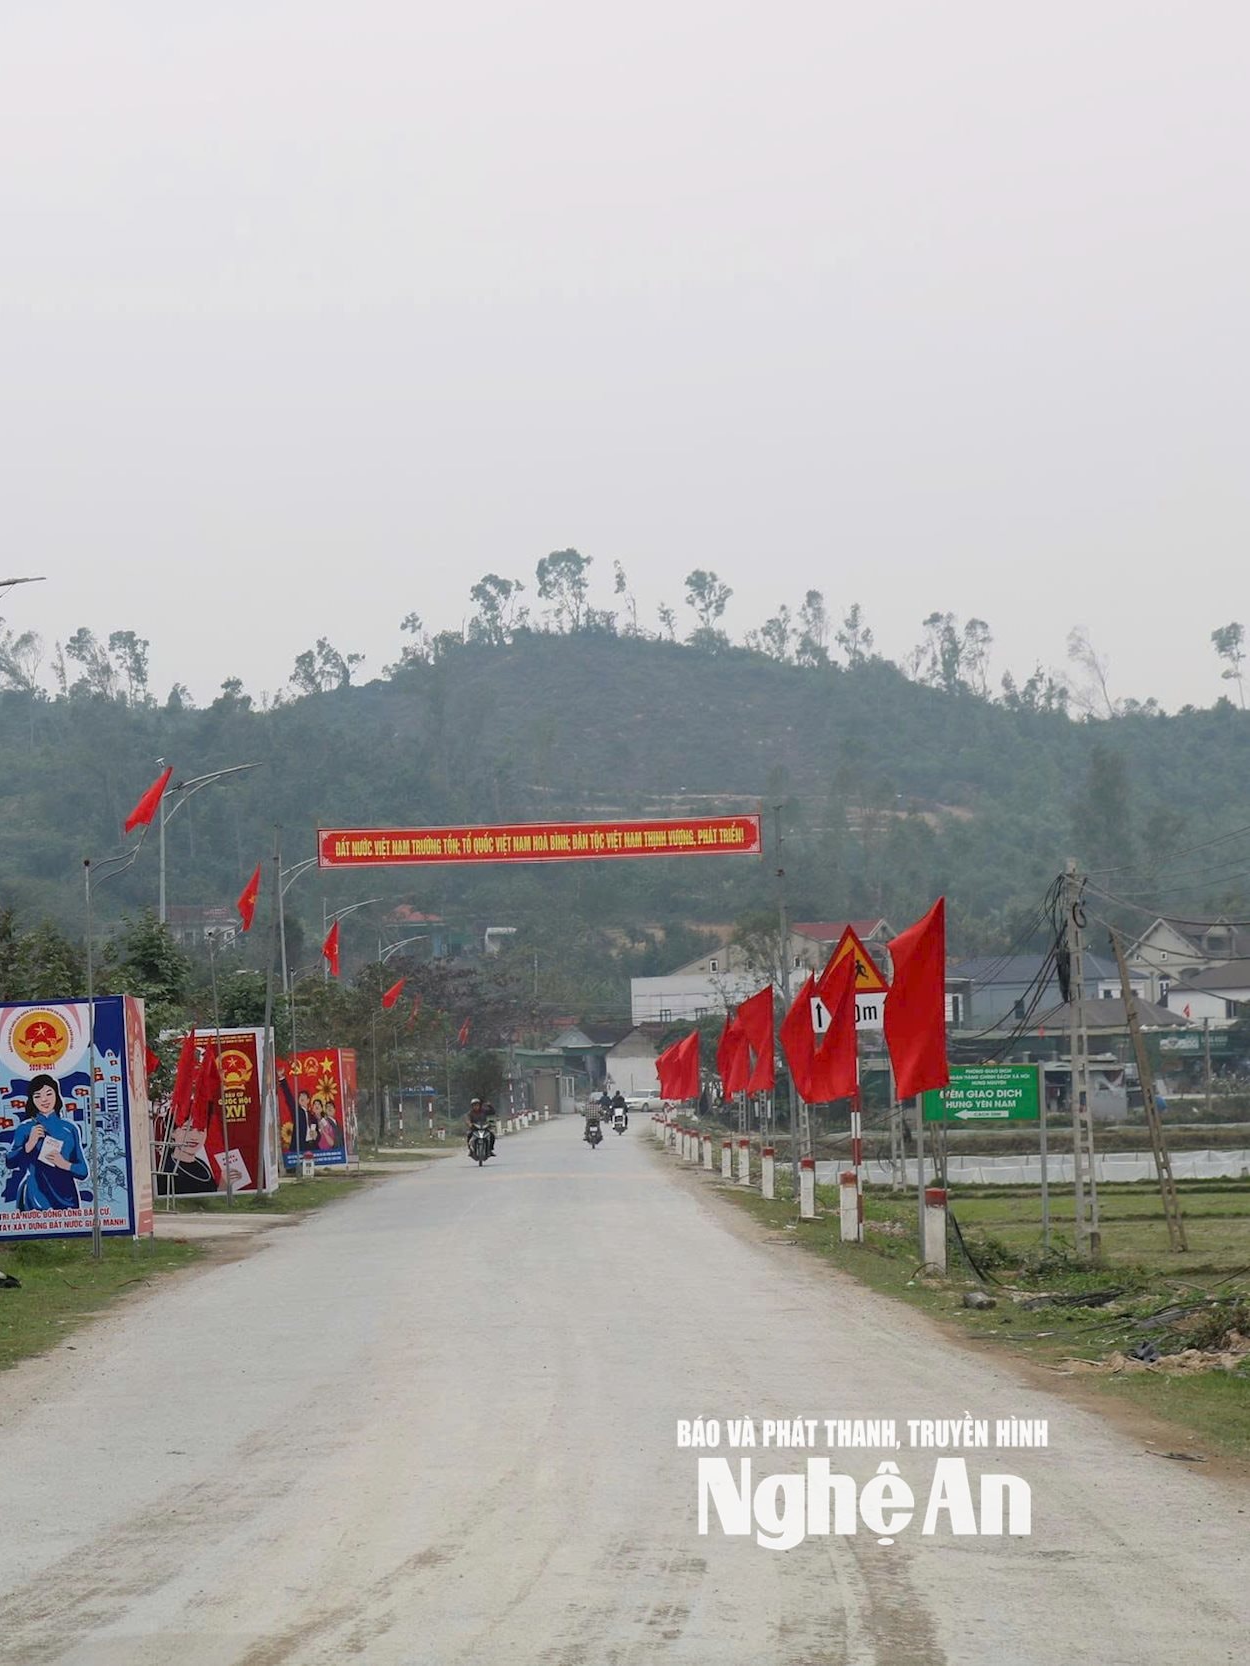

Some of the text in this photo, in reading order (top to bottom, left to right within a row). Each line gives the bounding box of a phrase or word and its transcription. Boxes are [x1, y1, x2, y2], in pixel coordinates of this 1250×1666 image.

[335, 835, 350, 857] ĐẤT
[352, 838, 373, 857] NƯỚC
[374, 837, 391, 859] VIỆT
[391, 840, 411, 855] NAM
[473, 832, 494, 855] QUỐC
[495, 833, 511, 856] VIỆT
[513, 835, 531, 852] NAM
[590, 830, 605, 853] TỘC
[606, 829, 623, 852] VIỆT
[624, 832, 642, 848] NAM
[643, 831, 667, 850] THỊNH
[697, 825, 718, 845] PHÁT
[966, 1089, 994, 1098] GIAO
[975, 1099, 992, 1108] YÊN
[994, 1100, 1016, 1108] NAM
[225, 1104, 246, 1118] XVI
[0, 1212, 10, 1221] TRI
[0, 1223, 11, 1232] TAY
